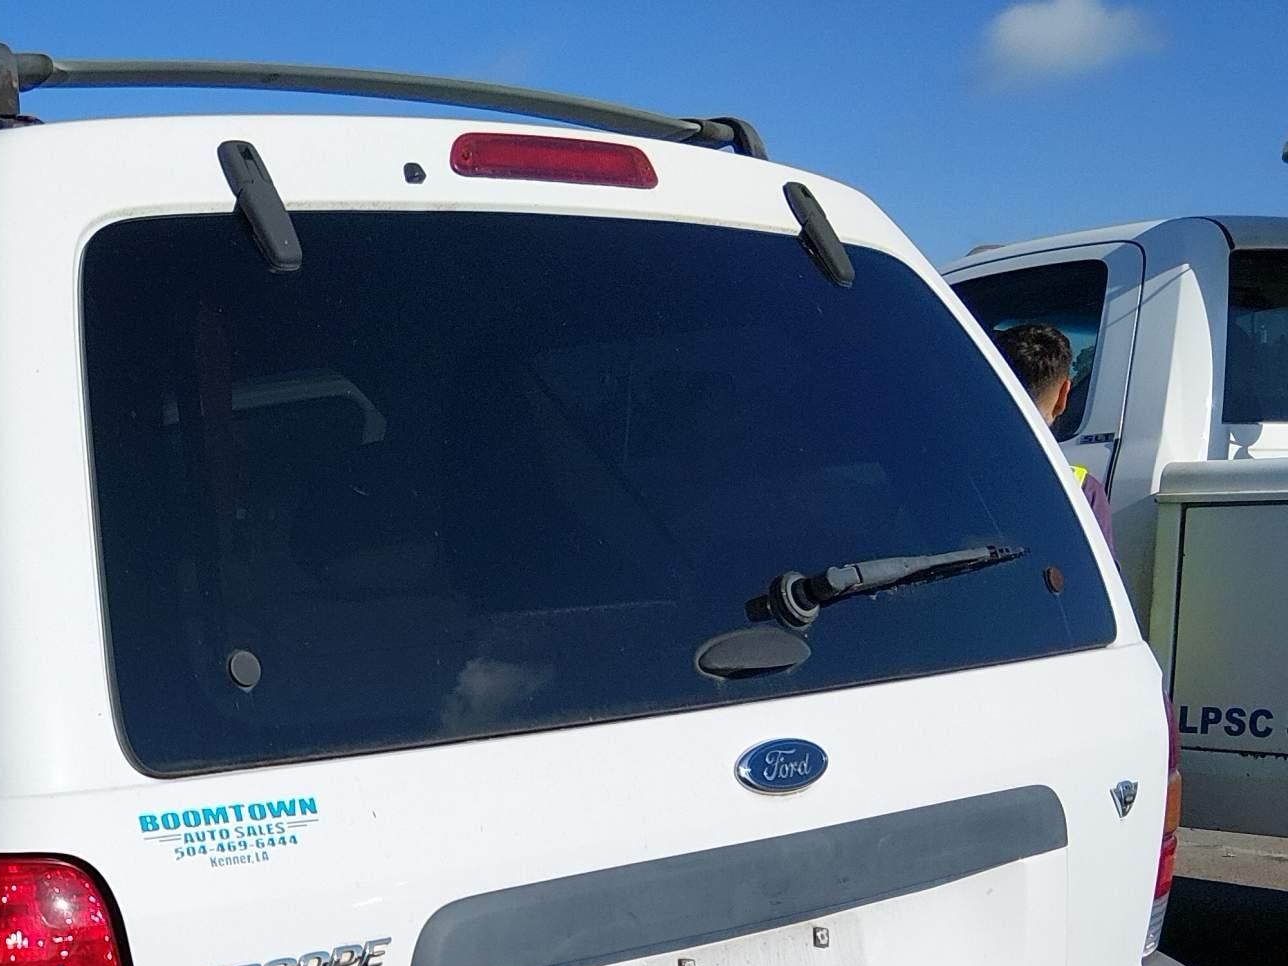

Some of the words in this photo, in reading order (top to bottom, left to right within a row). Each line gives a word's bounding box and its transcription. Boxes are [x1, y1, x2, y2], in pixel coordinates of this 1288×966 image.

[1178, 705, 1274, 738] LPSC
[763, 748, 812, 781] Ford
[139, 797, 319, 833] BOOMTOWN
[174, 834, 299, 861] 504-469-6444
[183, 828, 231, 845] AUTO
[234, 821, 286, 839] SALES
